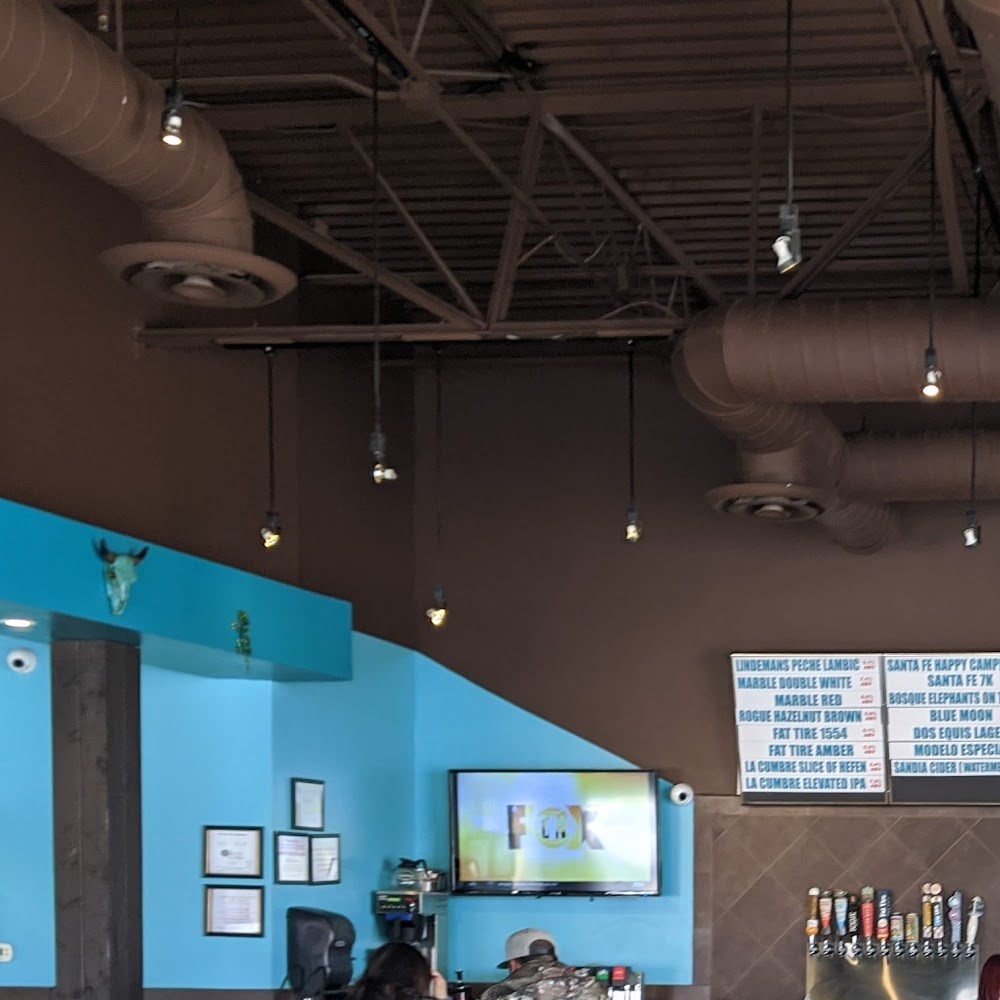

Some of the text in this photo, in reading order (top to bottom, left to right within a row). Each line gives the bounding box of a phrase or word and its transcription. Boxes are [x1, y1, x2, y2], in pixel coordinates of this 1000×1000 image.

[736, 660, 789, 671] LINDEMANS
[792, 660, 821, 671] PECHE
[823, 660, 859, 671] LAMBIC
[888, 659, 919, 671] SANTA
[922, 659, 931, 671] FE
[935, 659, 966, 671] HAPPY
[738, 677, 777, 689] MARBLE
[779, 677, 817, 689] DOUBLE
[819, 677, 852, 689] WHITE
[928, 675, 993, 686] SANTA FE 7K
[775, 695, 842, 706] MARBLE RED
[889, 692, 926, 705] BOSQUE
[928, 692, 980, 705] ELEPHANTS
[983, 692, 995, 705] ON
[739, 711, 771, 722] ROGUE
[774, 711, 821, 722] HAZELNUT
[824, 711, 861, 722] BROWN
[930, 709, 992, 721] BLUE MOON
[773, 728, 848, 739] FAT TIRE 1554
[914, 727, 936, 740] DOS
[939, 727, 971, 740] EQUIS
[769, 745, 786, 756] FAT
[789, 745, 813, 756] TIRE
[816, 745, 854, 756] AMBER
[914, 744, 957, 756] MODELO
[745, 761, 755, 772] LA
[758, 761, 796, 772] CUMBRE
[799, 761, 823, 772] SLICE
[894, 761, 927, 773] SANDIA
[930, 761, 956, 773] CIDER
[746, 778, 757, 789] LA
[760, 778, 800, 789] CUMBRE
[803, 778, 847, 789] ELEVATED
[850, 778, 866, 789] IPA
